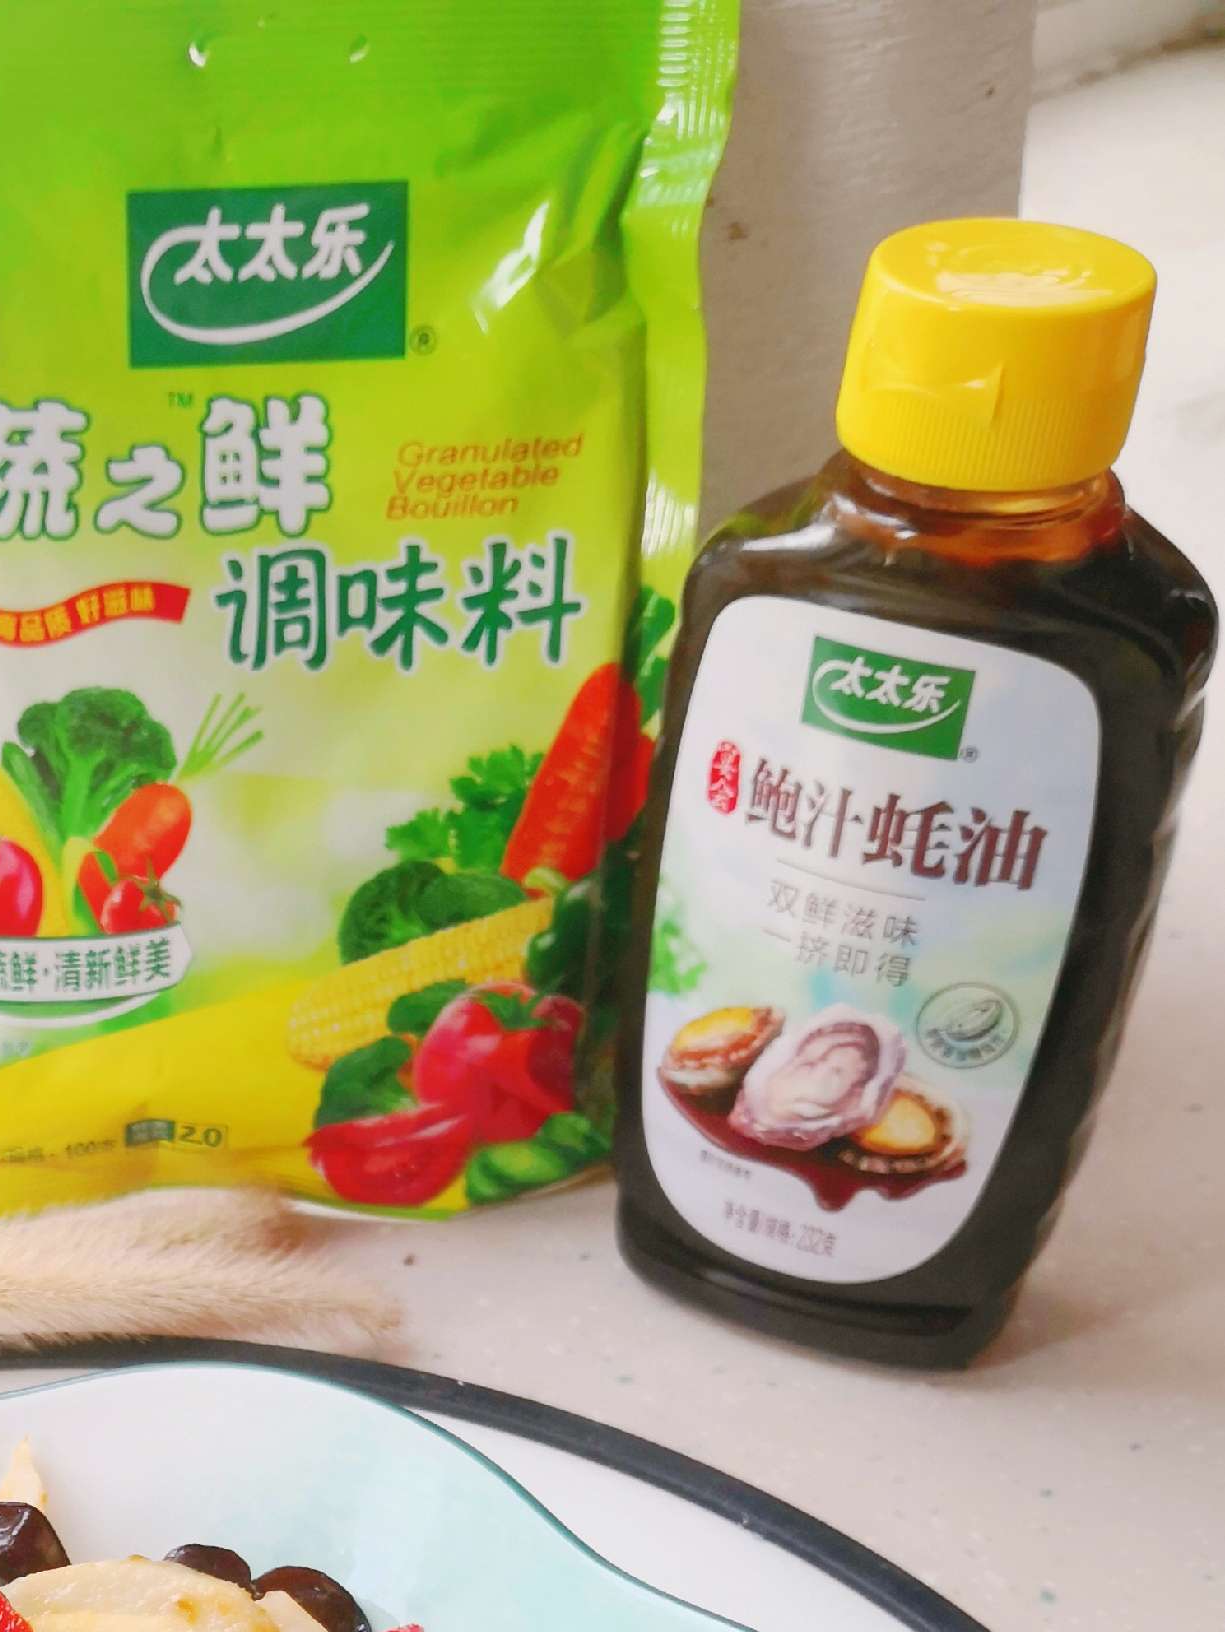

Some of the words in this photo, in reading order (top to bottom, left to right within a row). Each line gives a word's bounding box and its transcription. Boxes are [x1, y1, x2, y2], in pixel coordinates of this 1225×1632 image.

[164, 202, 370, 286] 太太乐
[397, 431, 585, 467] Granulated
[385, 493, 520, 521] Bouillon
[392, 463, 560, 498] Vegetable
[216, 538, 583, 672] 调味料
[829, 656, 952, 714] 太太乐
[744, 757, 1048, 890] 鲍汁蚝油
[767, 879, 919, 947] 双鲜滋味
[762, 926, 912, 988] 一挤即得
